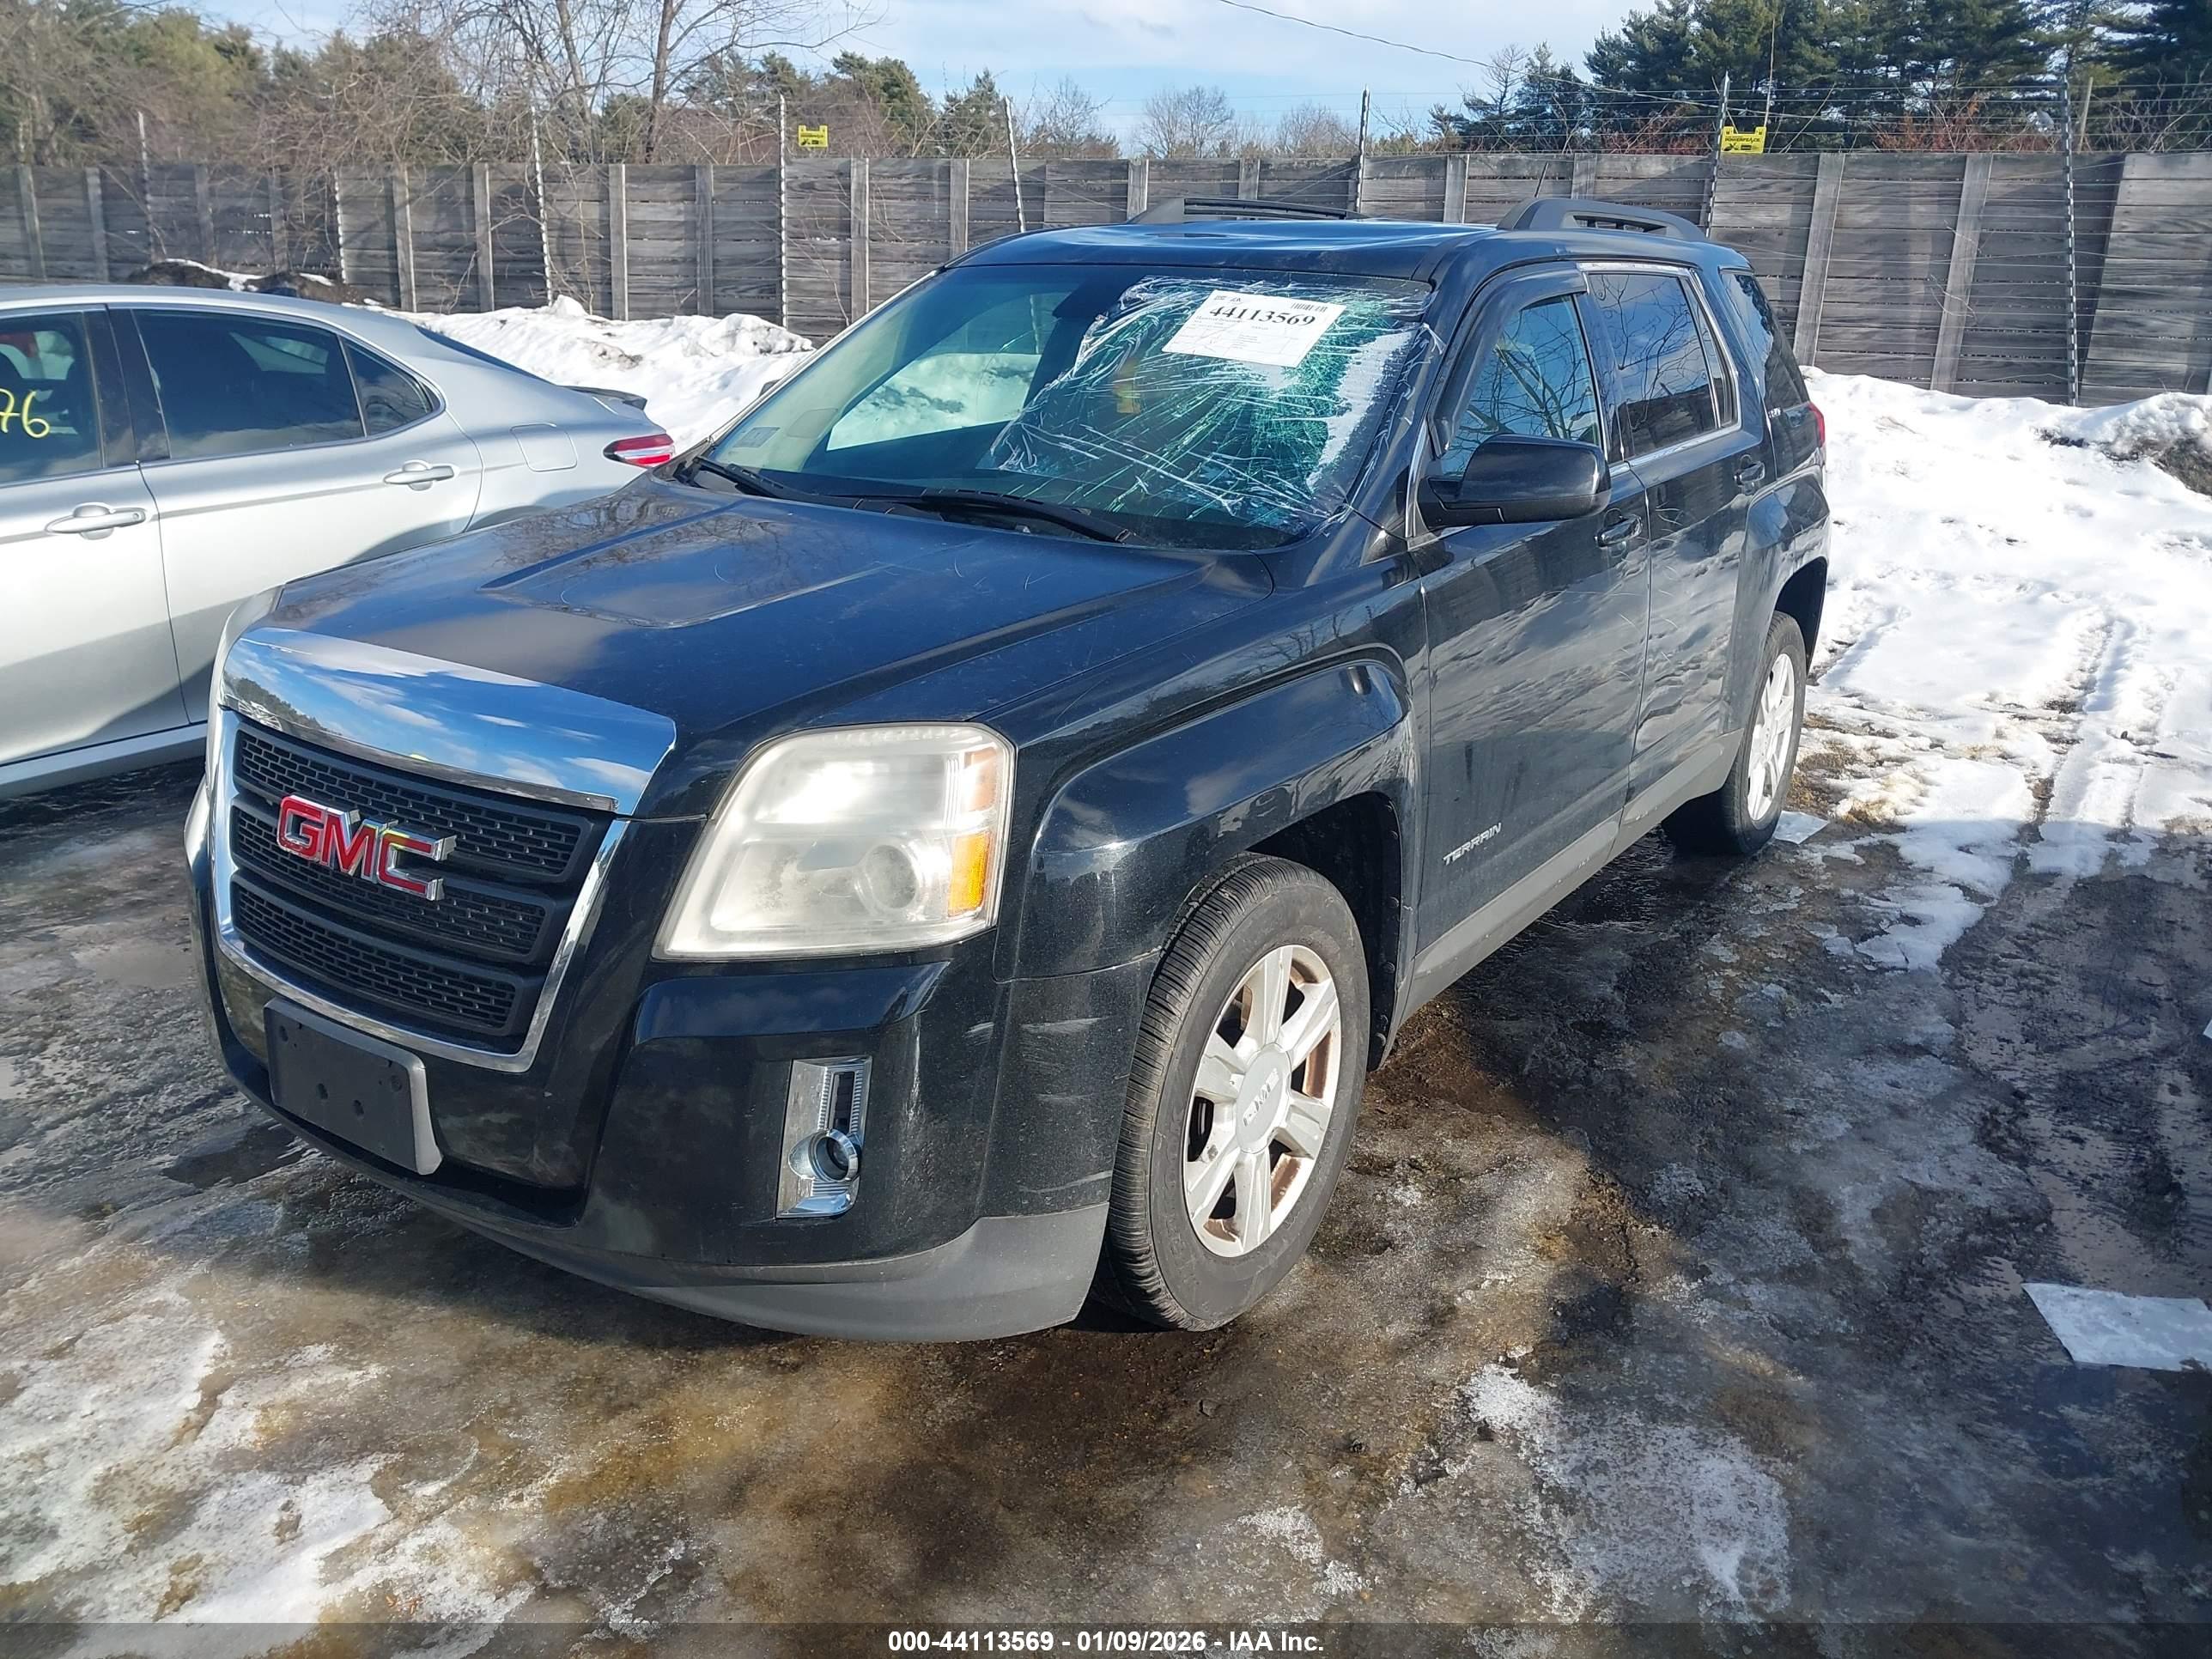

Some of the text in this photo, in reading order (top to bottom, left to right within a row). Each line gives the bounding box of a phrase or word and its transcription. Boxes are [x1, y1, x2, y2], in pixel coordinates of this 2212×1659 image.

[1209, 306, 1316, 326] 44113569
[276, 794, 450, 901] GMC
[1443, 822, 1502, 866] TERRAIN
